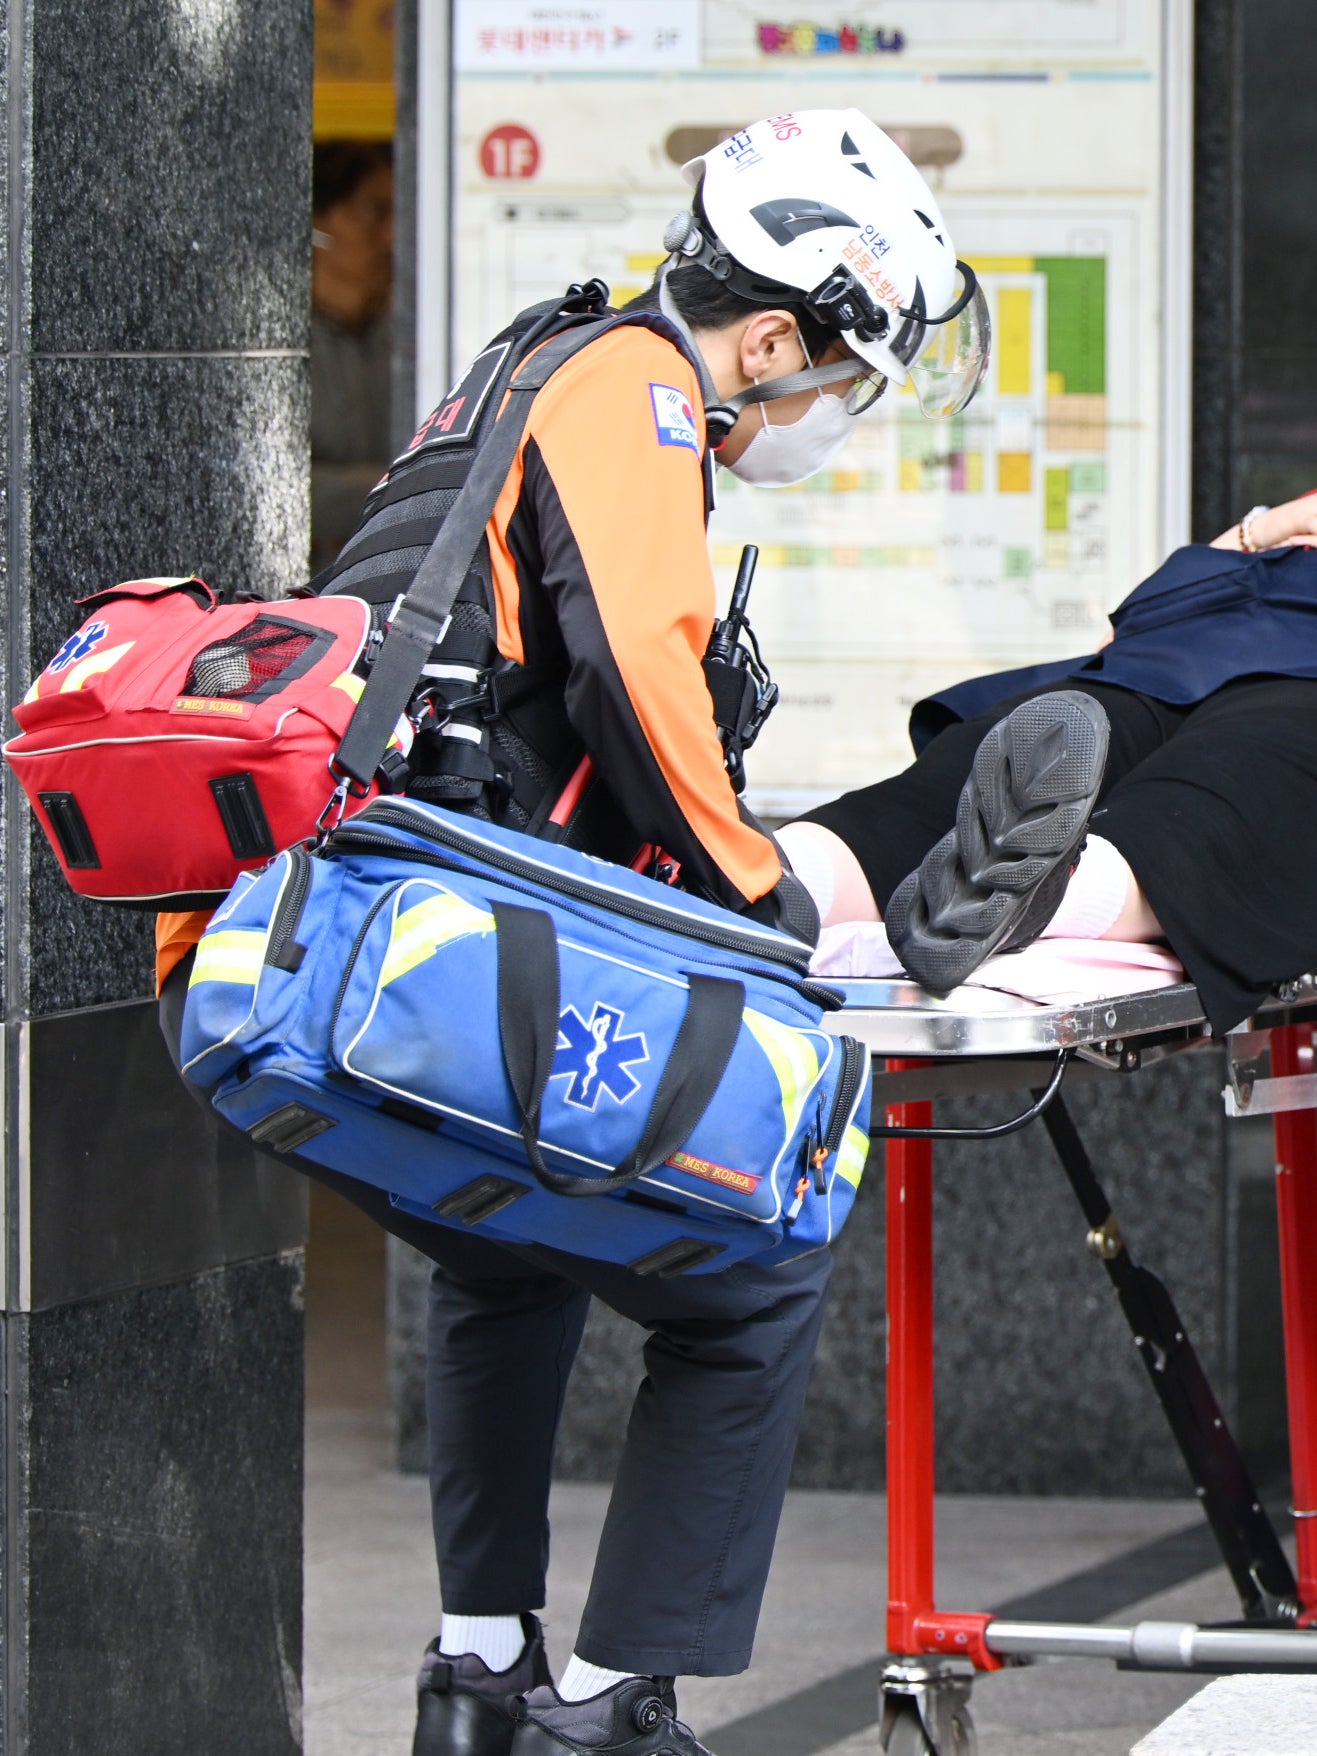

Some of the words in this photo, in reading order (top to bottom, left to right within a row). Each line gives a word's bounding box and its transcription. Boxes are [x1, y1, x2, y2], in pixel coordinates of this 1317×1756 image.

[490, 137, 534, 178] 1F
[858, 224, 891, 260] 인천
[842, 238, 906, 313] 남동소방서
[184, 698, 205, 710] MES
[208, 700, 244, 714] KOREA
[683, 1155, 708, 1174] MES
[711, 1165, 751, 1188] KOREA
